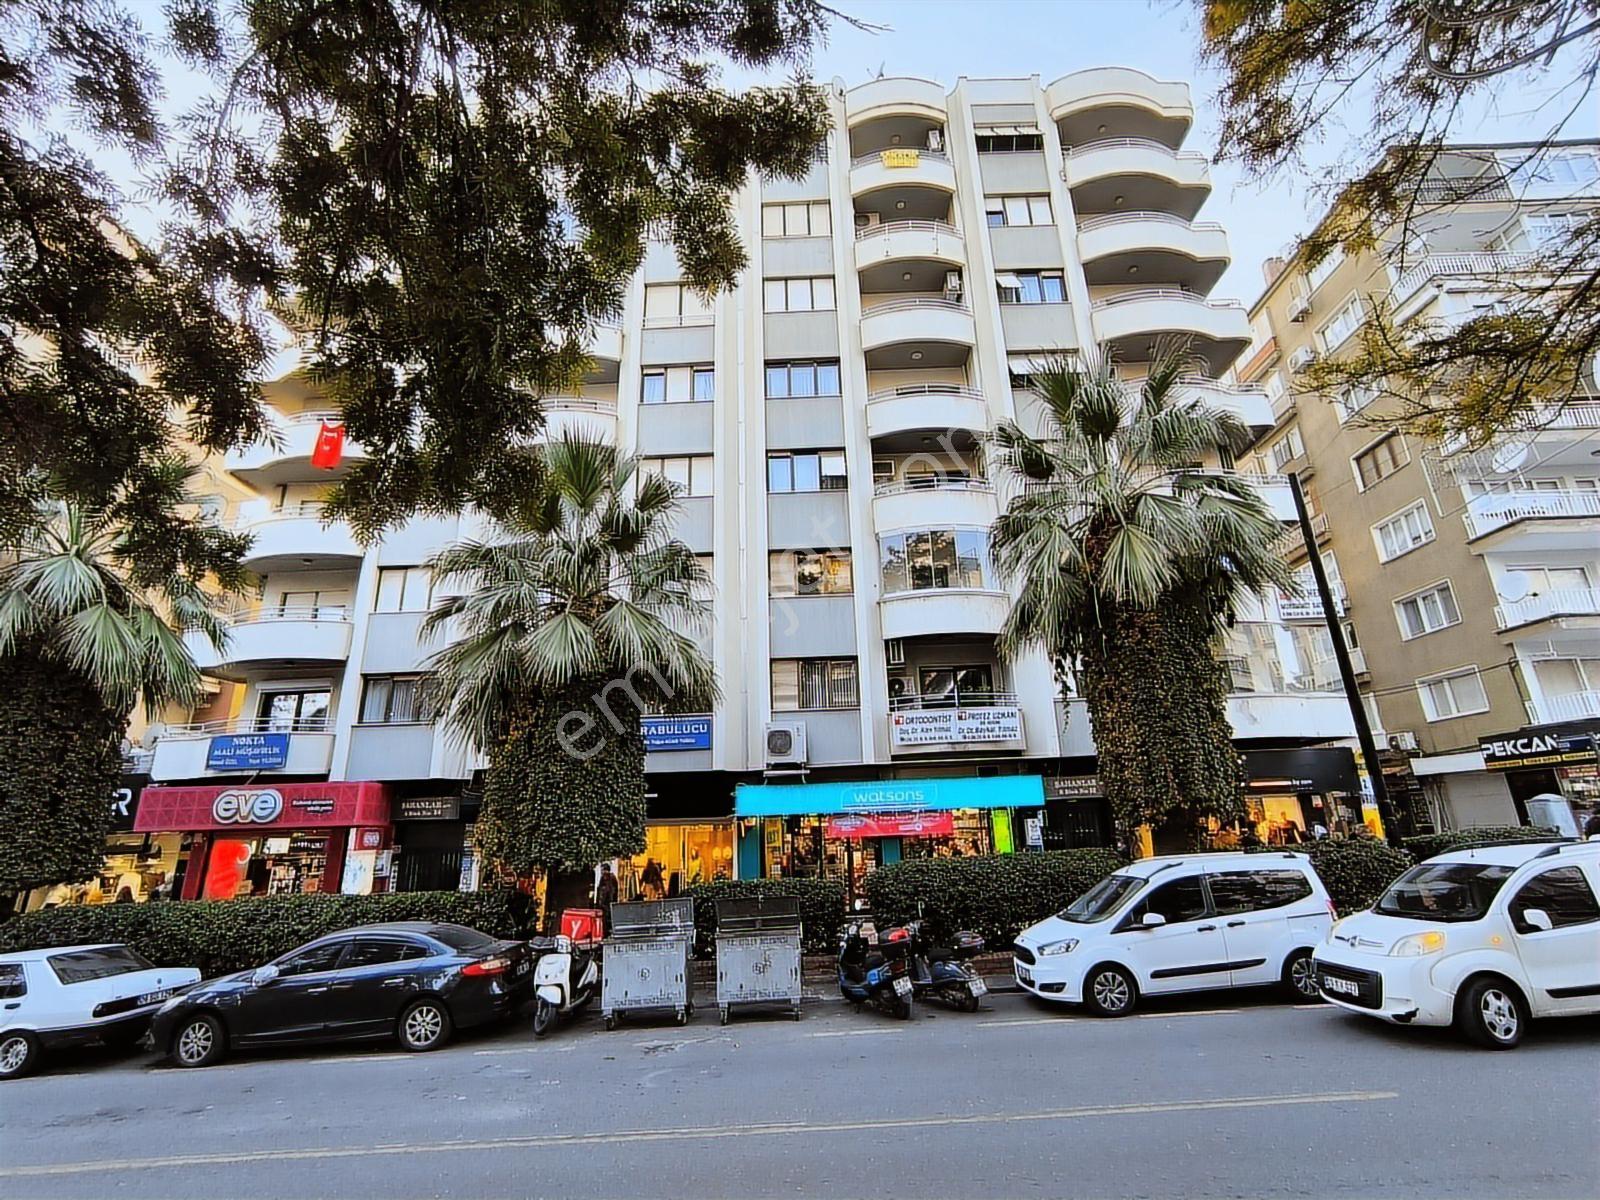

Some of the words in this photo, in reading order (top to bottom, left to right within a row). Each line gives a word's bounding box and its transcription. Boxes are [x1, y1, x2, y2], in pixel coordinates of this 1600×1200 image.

[640, 723, 708, 736] RABULUCU
[1481, 734, 1558, 758] PEKCAN
[853, 789, 924, 802] watsons
[214, 790, 281, 823] eve
